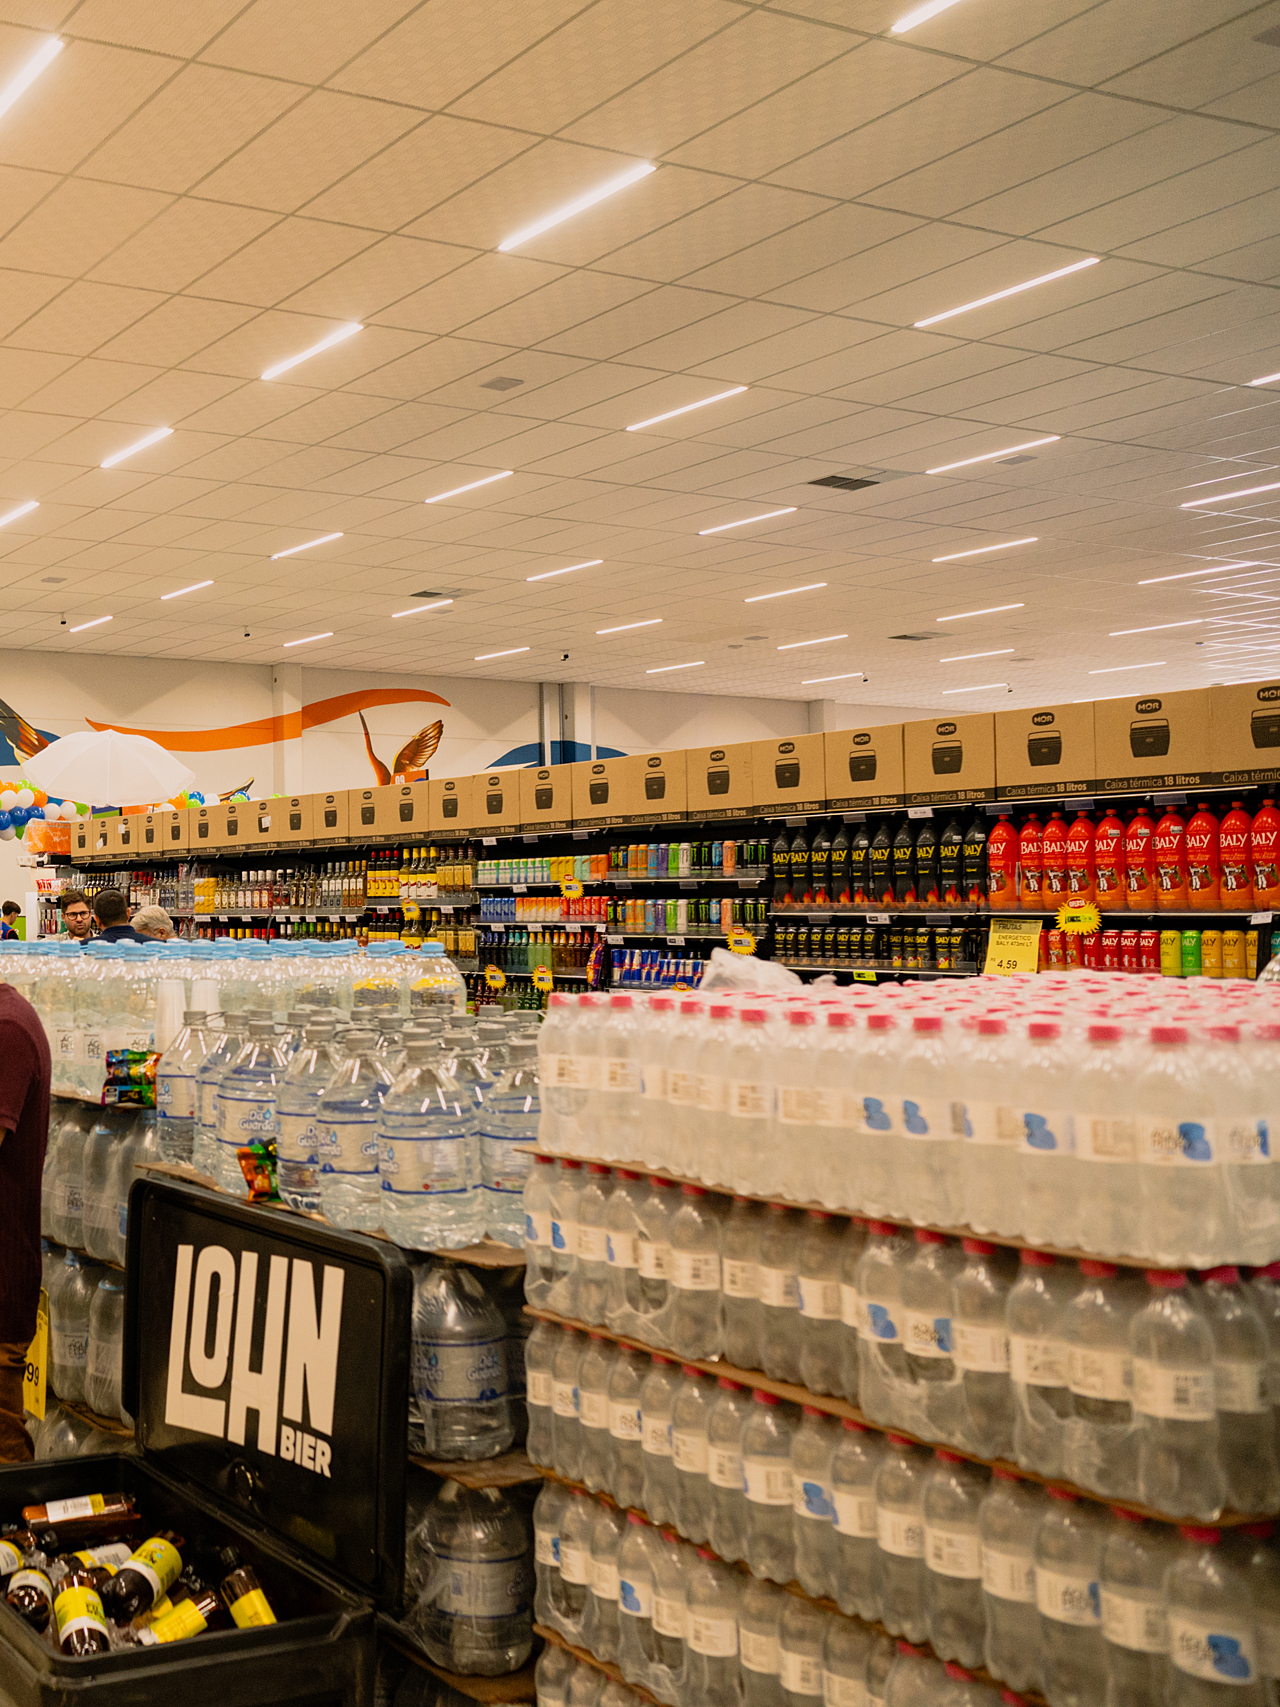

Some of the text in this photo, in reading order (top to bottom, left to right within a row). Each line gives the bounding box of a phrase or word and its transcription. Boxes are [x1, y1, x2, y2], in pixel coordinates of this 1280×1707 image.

[1137, 702, 1160, 711] MOR
[1033, 715, 1053, 724] MOR
[938, 725, 955, 733] MOR
[854, 736, 870, 744] MOR
[1104, 775, 1200, 789] Caixa térmica 18 litros
[1223, 769, 1280, 783] Caixa térmic
[1006, 783, 1087, 796] Caixa térmica 18 litros
[832, 796, 897, 808] Caixa térmica 18 litros
[912, 790, 985, 803] Caixa térmica 18 litros
[760, 806, 775, 814] Caixa
[796, 803, 803, 811] 18
[1155, 835, 1180, 849] BALY
[1186, 834, 1211, 848] BALY
[1220, 833, 1248, 847] BALY
[1251, 831, 1277, 846] BALY
[989, 842, 1006, 854] ALY
[1043, 841, 1067, 853] BALY
[790, 851, 809, 863] BALY
[998, 923, 1023, 931] FRUTAS
[1083, 937, 1096, 946] ALY
[1101, 937, 1119, 947] BALY
[997, 959, 1018, 970] 4,59
[248, 1109, 264, 1121] Da
[238, 1118, 275, 1131] Guarda
[165, 1243, 345, 1456] LOHN
[279, 1424, 333, 1478] BIER
